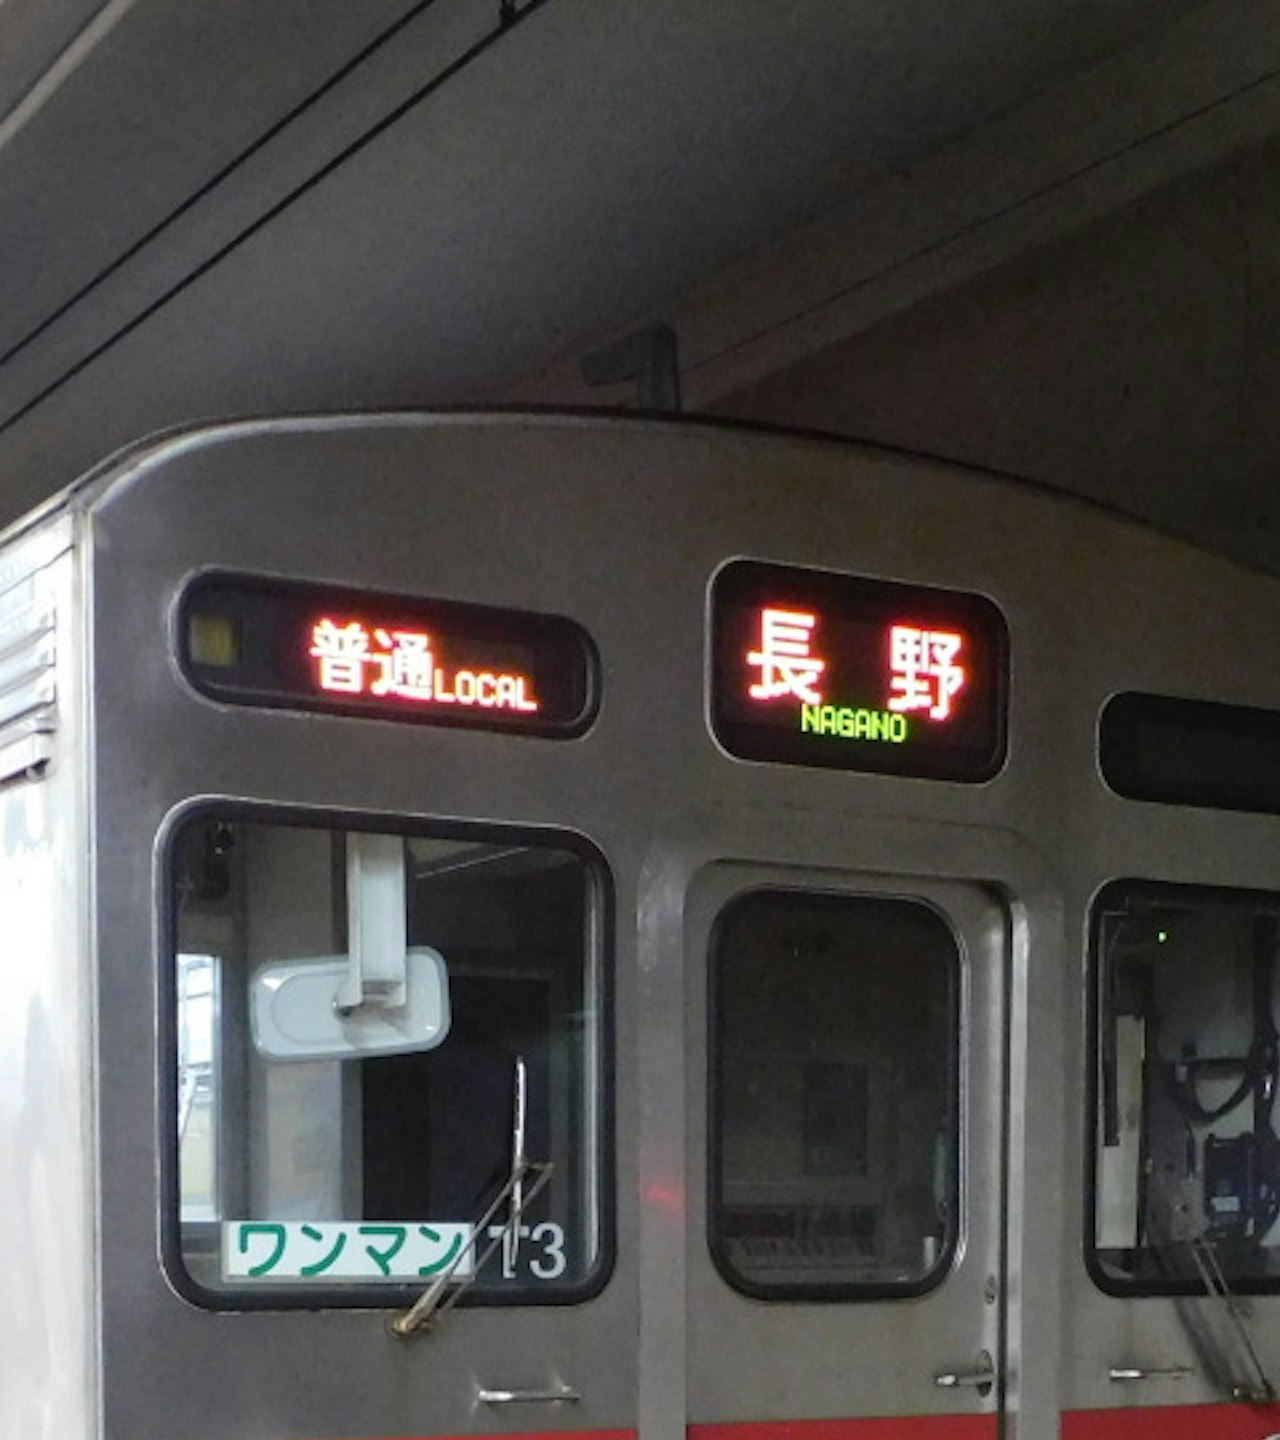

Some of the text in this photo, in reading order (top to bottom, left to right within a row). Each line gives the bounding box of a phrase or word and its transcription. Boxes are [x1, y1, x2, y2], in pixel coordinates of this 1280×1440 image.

[311, 620, 538, 712] 普通 LOCAL
[747, 609, 964, 721] 長野
[801, 703, 908, 743] NAGANO
[239, 1224, 463, 1277] ワンマン
